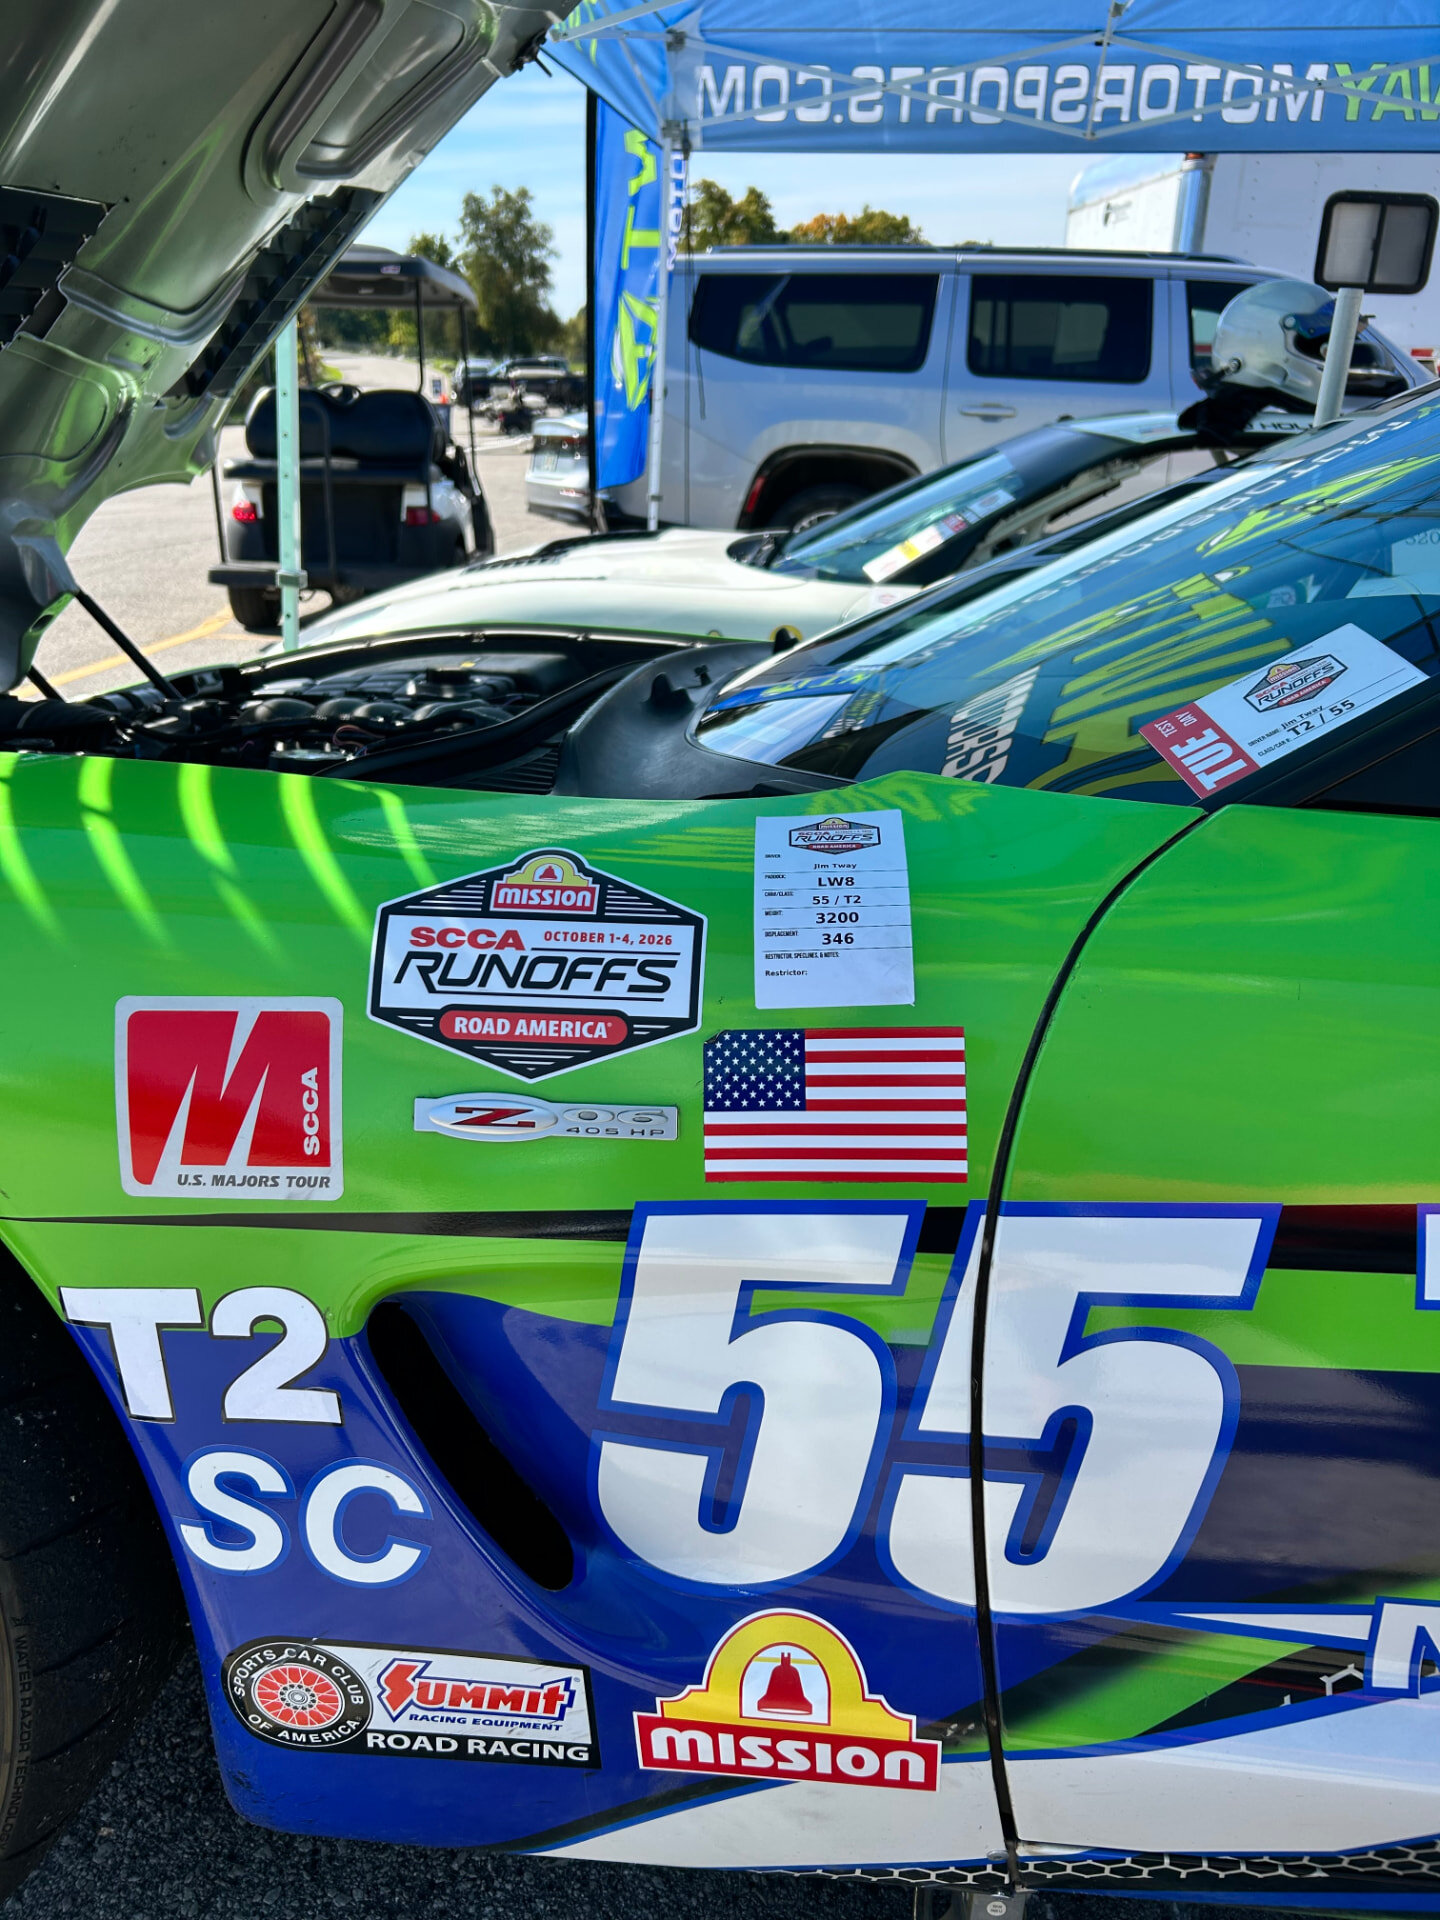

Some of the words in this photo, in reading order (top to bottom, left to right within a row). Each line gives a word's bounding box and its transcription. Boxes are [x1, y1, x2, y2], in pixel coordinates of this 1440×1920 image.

[1257, 663, 1336, 706] RUNOFFS
[1154, 720, 1178, 738] TEST
[1174, 711, 1198, 727] DAY
[1281, 716, 1299, 730] Jim
[1299, 704, 1324, 721] Tway
[1287, 720, 1315, 738] T2
[1329, 699, 1356, 716] 55
[1169, 727, 1248, 792] TUE
[794, 833, 874, 843] RUNOFFS
[817, 877, 855, 887] LW8
[812, 895, 830, 905] 55
[834, 895, 840, 905] /
[844, 894, 861, 904] T2
[815, 911, 859, 924] 3200
[409, 926, 526, 951] SCCA
[543, 930, 605, 945] OCTOBER
[609, 933, 635, 946] 1-4,
[639, 933, 673, 946] 2026
[821, 932, 854, 945] 346
[393, 950, 678, 994] RUNOFFS
[454, 1015, 512, 1037] ROAD
[301, 1066, 321, 1156] SCCA
[566, 1126, 619, 1135] 405
[630, 1128, 665, 1136] HP
[177, 1173, 207, 1187] U.S.
[211, 1174, 280, 1188] MAJORS
[285, 1175, 331, 1188] TOUR
[59, 1286, 344, 1425] T2
[599, 1210, 1268, 1614] 55
[178, 1449, 427, 1585] SC
[15, 1634, 33, 1693] WATER
[233, 1648, 277, 1699] SPORTS
[283, 1646, 328, 1668] CAR
[332, 1664, 365, 1706] CLUB
[19, 1698, 33, 1753] RAZOR
[247, 1712, 273, 1731] OF
[408, 1712, 468, 1725] RACING
[471, 1717, 563, 1732] EQUIPMENT
[366, 1732, 459, 1752] ROAD
[466, 1738, 590, 1761] RACING
